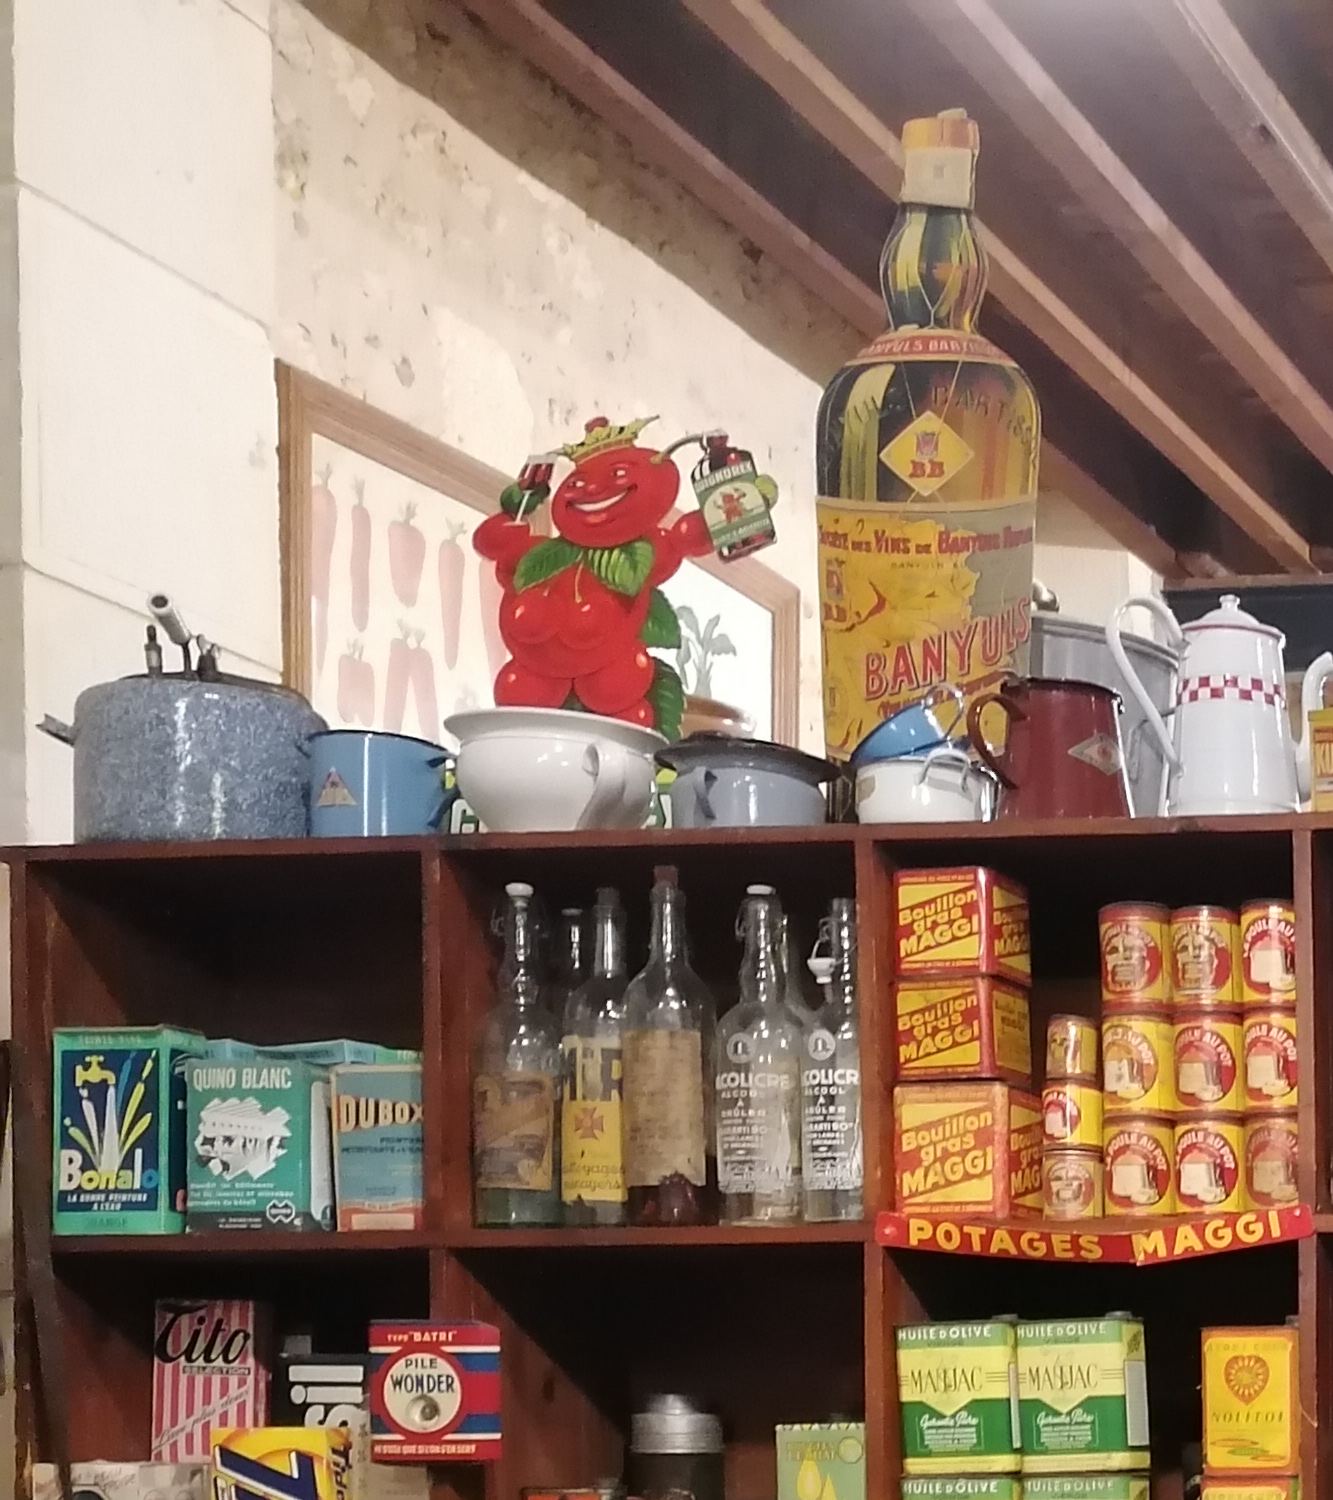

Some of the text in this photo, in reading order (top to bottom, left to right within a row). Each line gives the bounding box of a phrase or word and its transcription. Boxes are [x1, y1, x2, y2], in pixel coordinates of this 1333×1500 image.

[864, 596, 1030, 700] BANYULS
[899, 889, 977, 926] Bouillon
[914, 906, 962, 935] gras
[899, 918, 979, 958] MAGGI
[897, 993, 977, 1029] Bouillon
[913, 1012, 962, 1041] gras
[899, 1023, 979, 1063] MAGGI
[193, 1066, 292, 1092] QUINO BLANC
[338, 1094, 424, 1133] DUBOX
[901, 1110, 993, 1152] Bouillon
[920, 1134, 976, 1167] gras
[59, 1148, 159, 1191] Bonalo
[901, 1150, 994, 1197] MAGGI
[907, 1211, 1283, 1262] POTAGES MAGGI
[153, 1303, 251, 1364] Tito
[899, 1327, 935, 1341] HUILE
[1017, 1325, 1053, 1339] HUILE
[404, 1357, 438, 1370] PILE
[389, 1373, 456, 1396] WONDER
[903, 1480, 942, 1495] HUILE
[1023, 1479, 1060, 1494] HUILE
